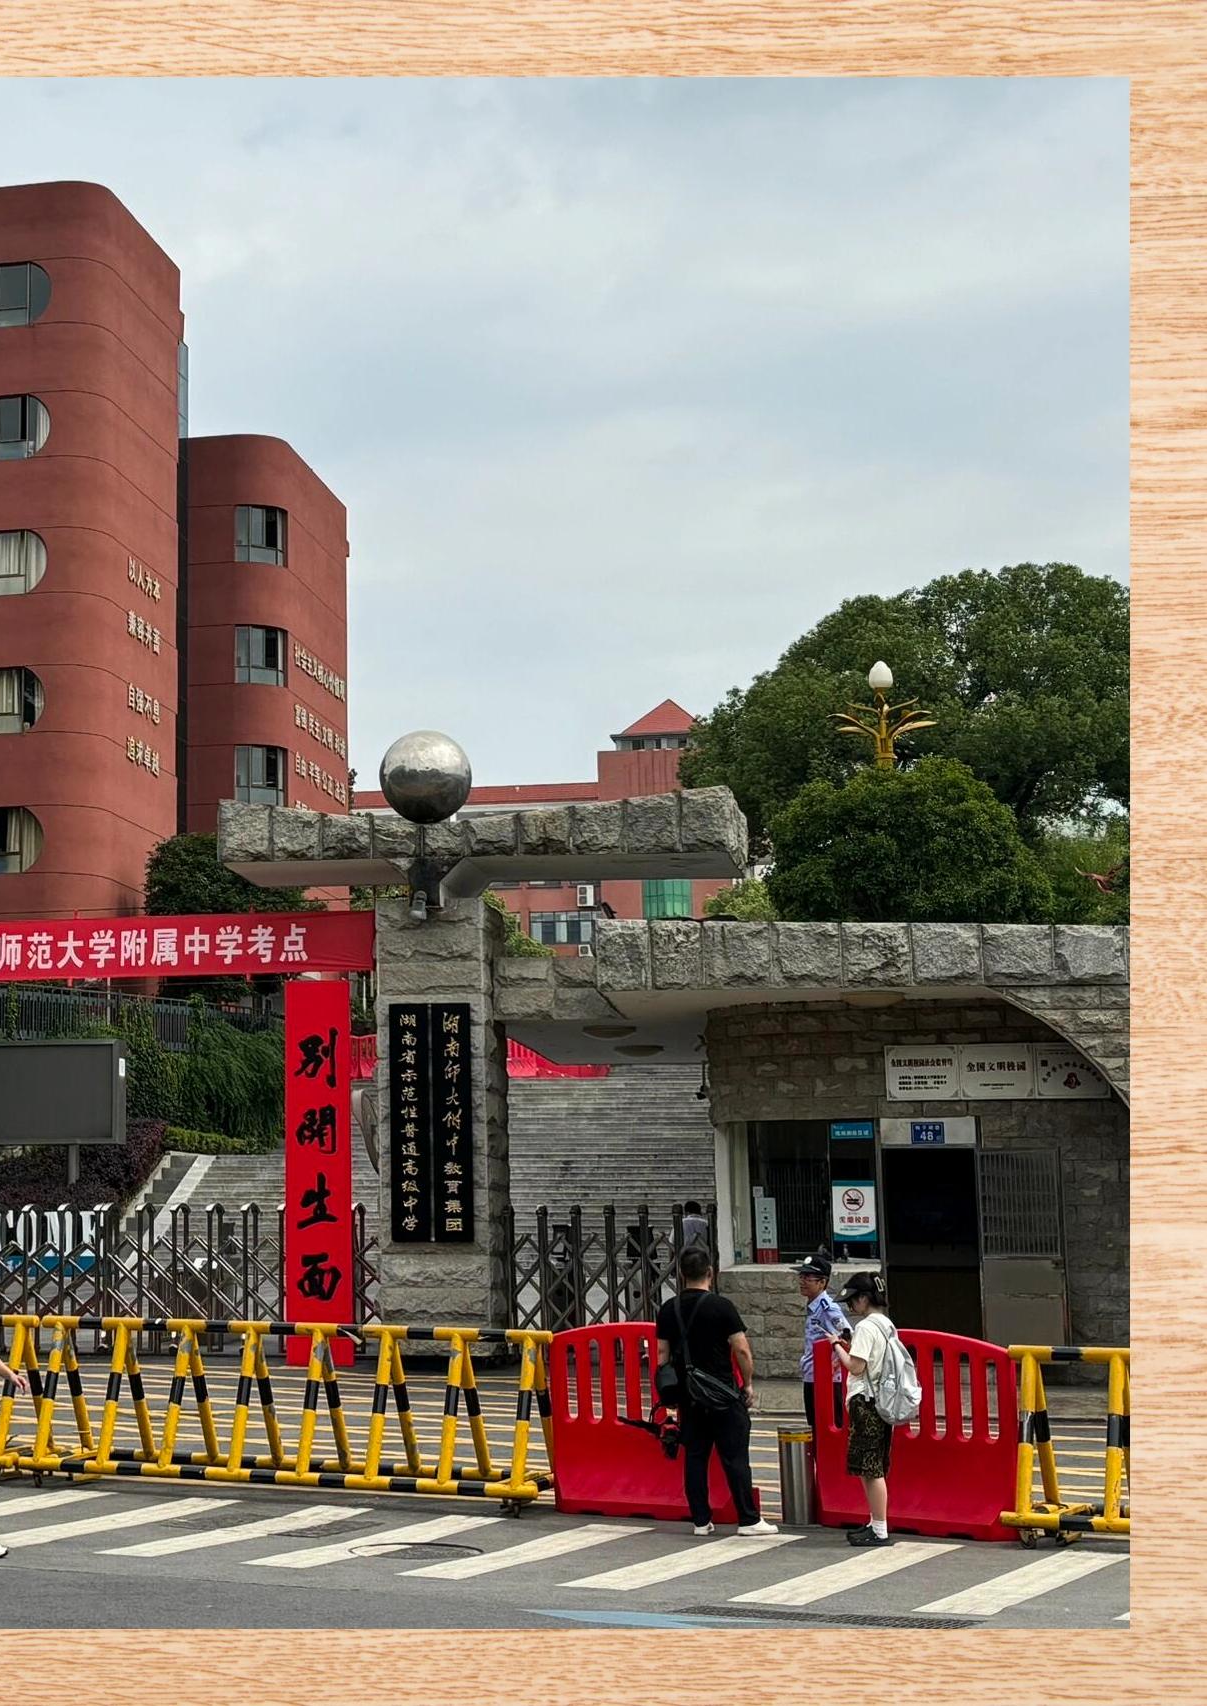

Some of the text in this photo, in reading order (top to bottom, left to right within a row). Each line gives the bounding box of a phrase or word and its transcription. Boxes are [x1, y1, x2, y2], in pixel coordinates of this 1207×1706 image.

[127, 556, 161, 603] 以人为本
[127, 683, 160, 724] 自强不息
[126, 736, 160, 776] 追求卓越
[966, 1061, 1026, 1072] 全国文明校园
[398, 1013, 421, 1232] 湖南省示范性普通高级中学
